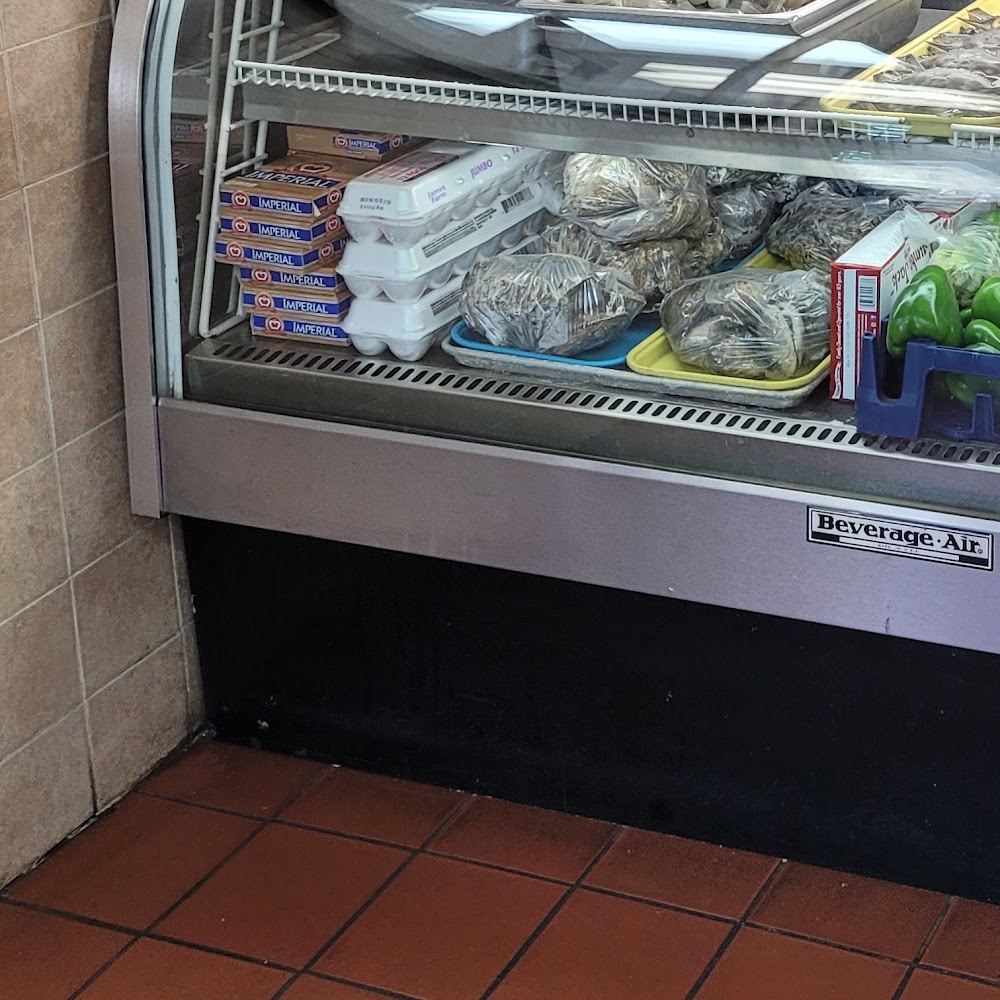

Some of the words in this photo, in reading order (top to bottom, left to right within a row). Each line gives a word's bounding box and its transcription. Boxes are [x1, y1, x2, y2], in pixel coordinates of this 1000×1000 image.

[349, 139, 379, 150] IMPERIAL
[470, 159, 493, 180] JUMBO
[245, 170, 333, 188] IMPERIAL
[258, 197, 302, 213] IMPERIAL
[258, 224, 301, 240] IMPERIAL
[252, 249, 294, 266] IMPERIAL
[280, 272, 326, 287] IMPERIAL
[283, 298, 328, 314] IMPERIAL
[293, 322, 337, 338] IMPERIAL
